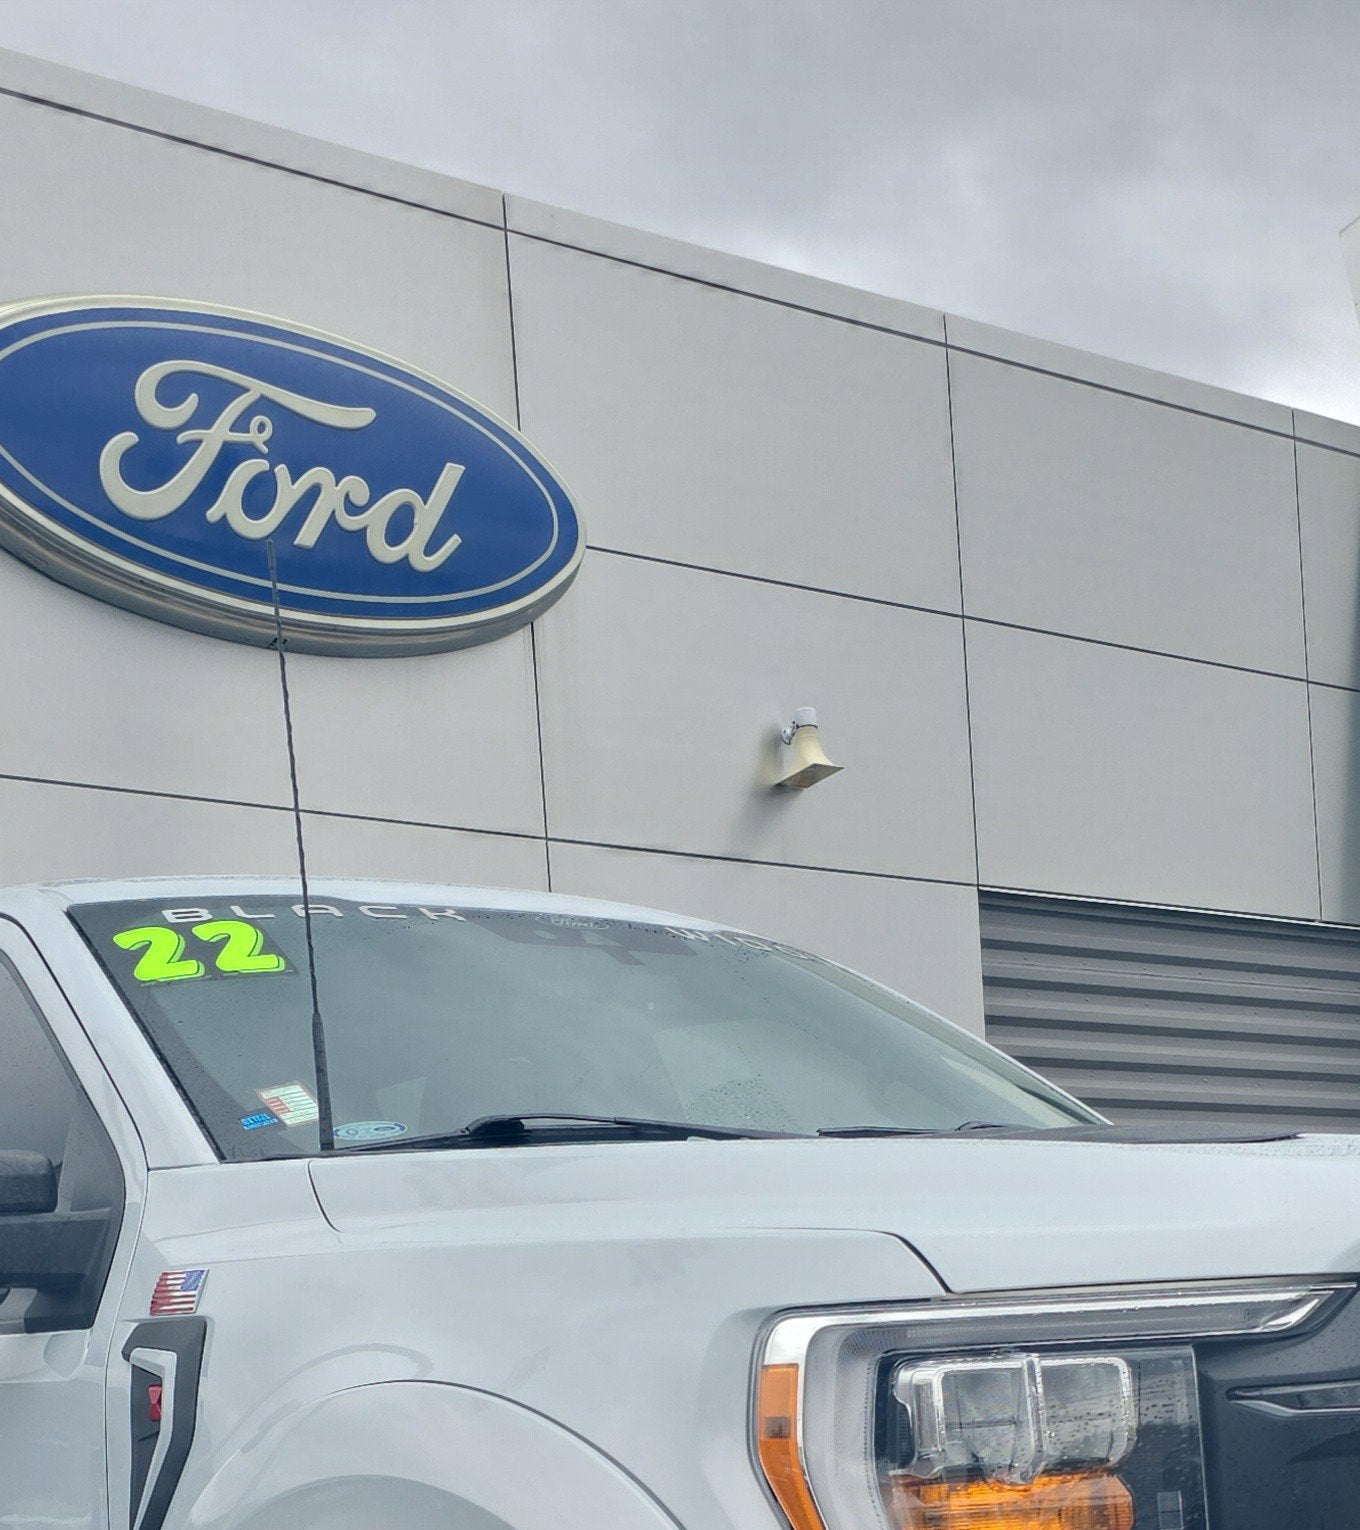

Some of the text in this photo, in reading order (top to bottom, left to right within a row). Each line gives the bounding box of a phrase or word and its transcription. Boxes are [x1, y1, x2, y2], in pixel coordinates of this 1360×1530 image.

[99, 360, 464, 573] Ford
[161, 904, 467, 924] BLACK
[112, 920, 287, 982] 22
